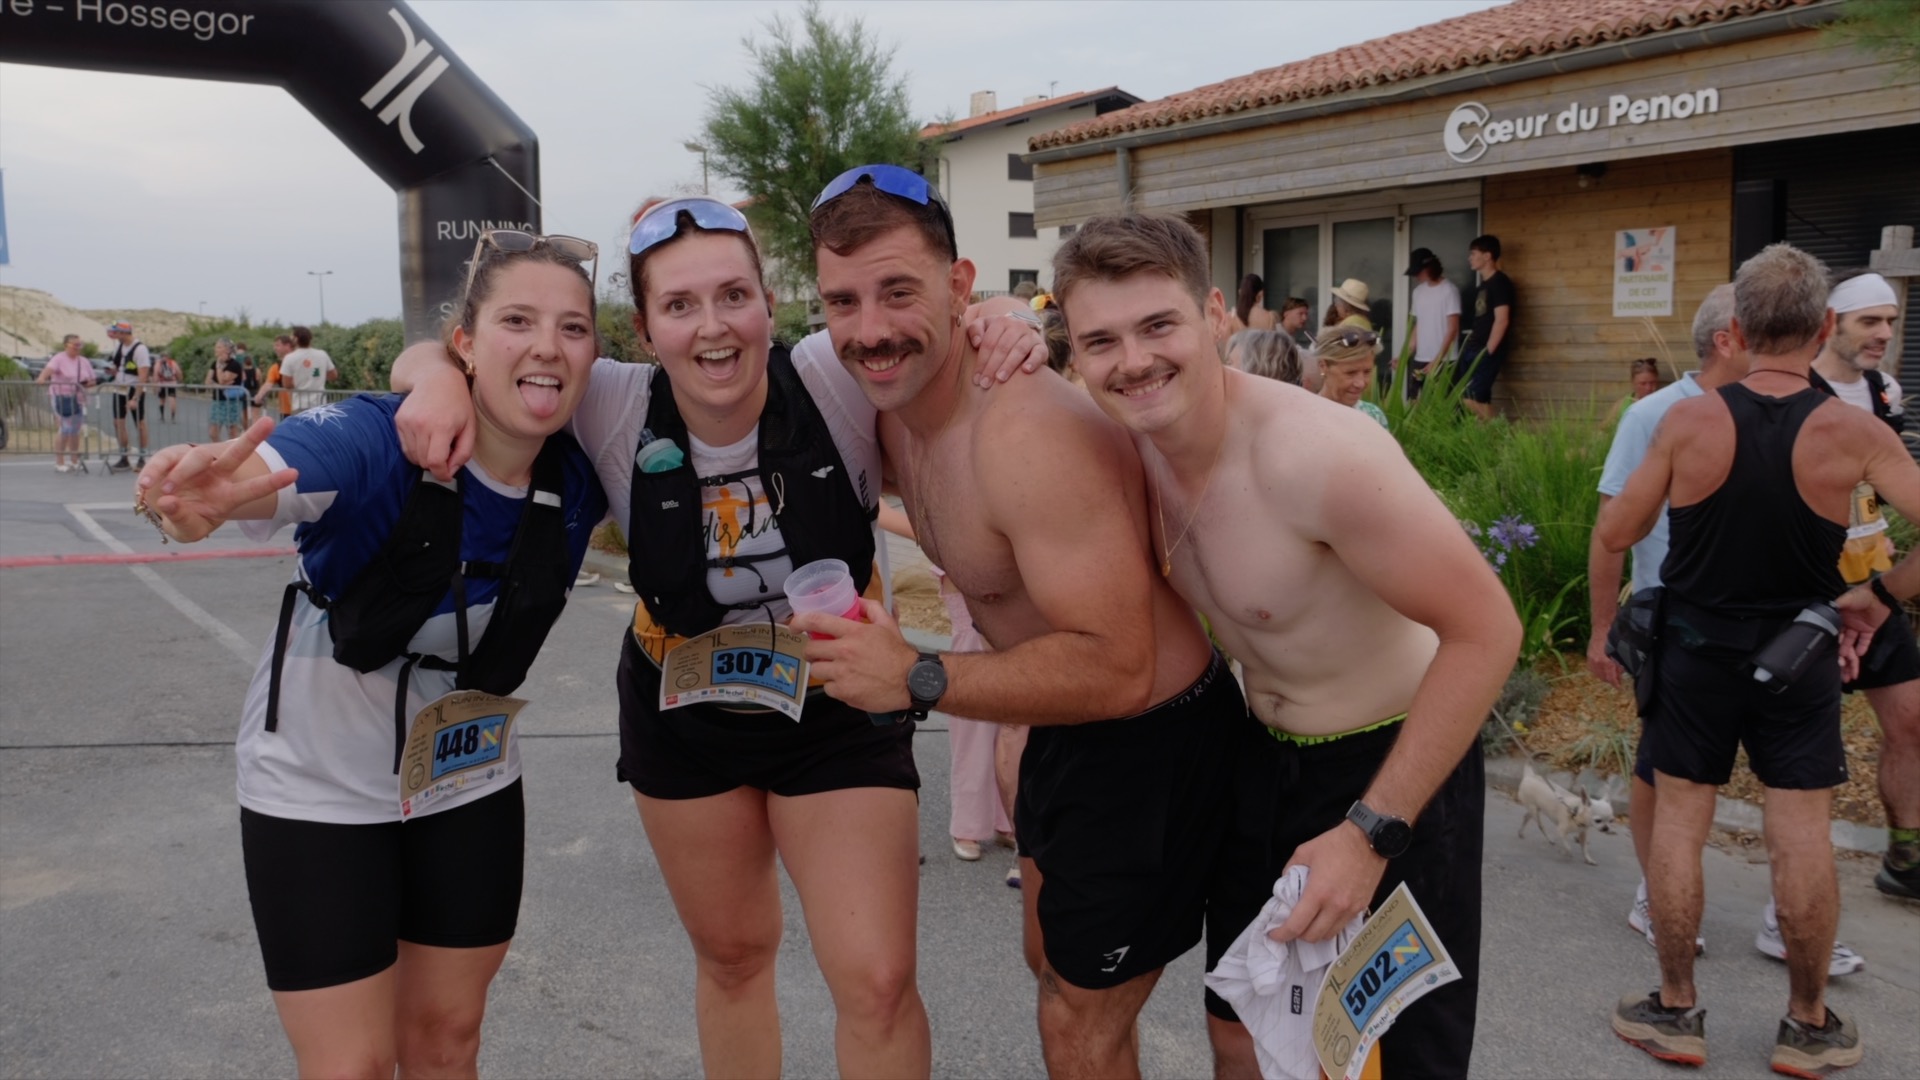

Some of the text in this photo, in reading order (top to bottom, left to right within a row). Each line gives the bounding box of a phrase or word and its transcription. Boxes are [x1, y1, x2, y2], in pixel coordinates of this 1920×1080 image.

[77, 0, 257, 41] Hossegor
[1443, 87, 1719, 163] Cœur du Penon
[1618, 273, 1669, 284] PARTENAIRE
[1629, 287, 1657, 297] DE CET
[717, 651, 770, 676] 307
[435, 724, 479, 763] 448
[1345, 951, 1398, 1016] 502
[1293, 987, 1301, 1013] 42K
